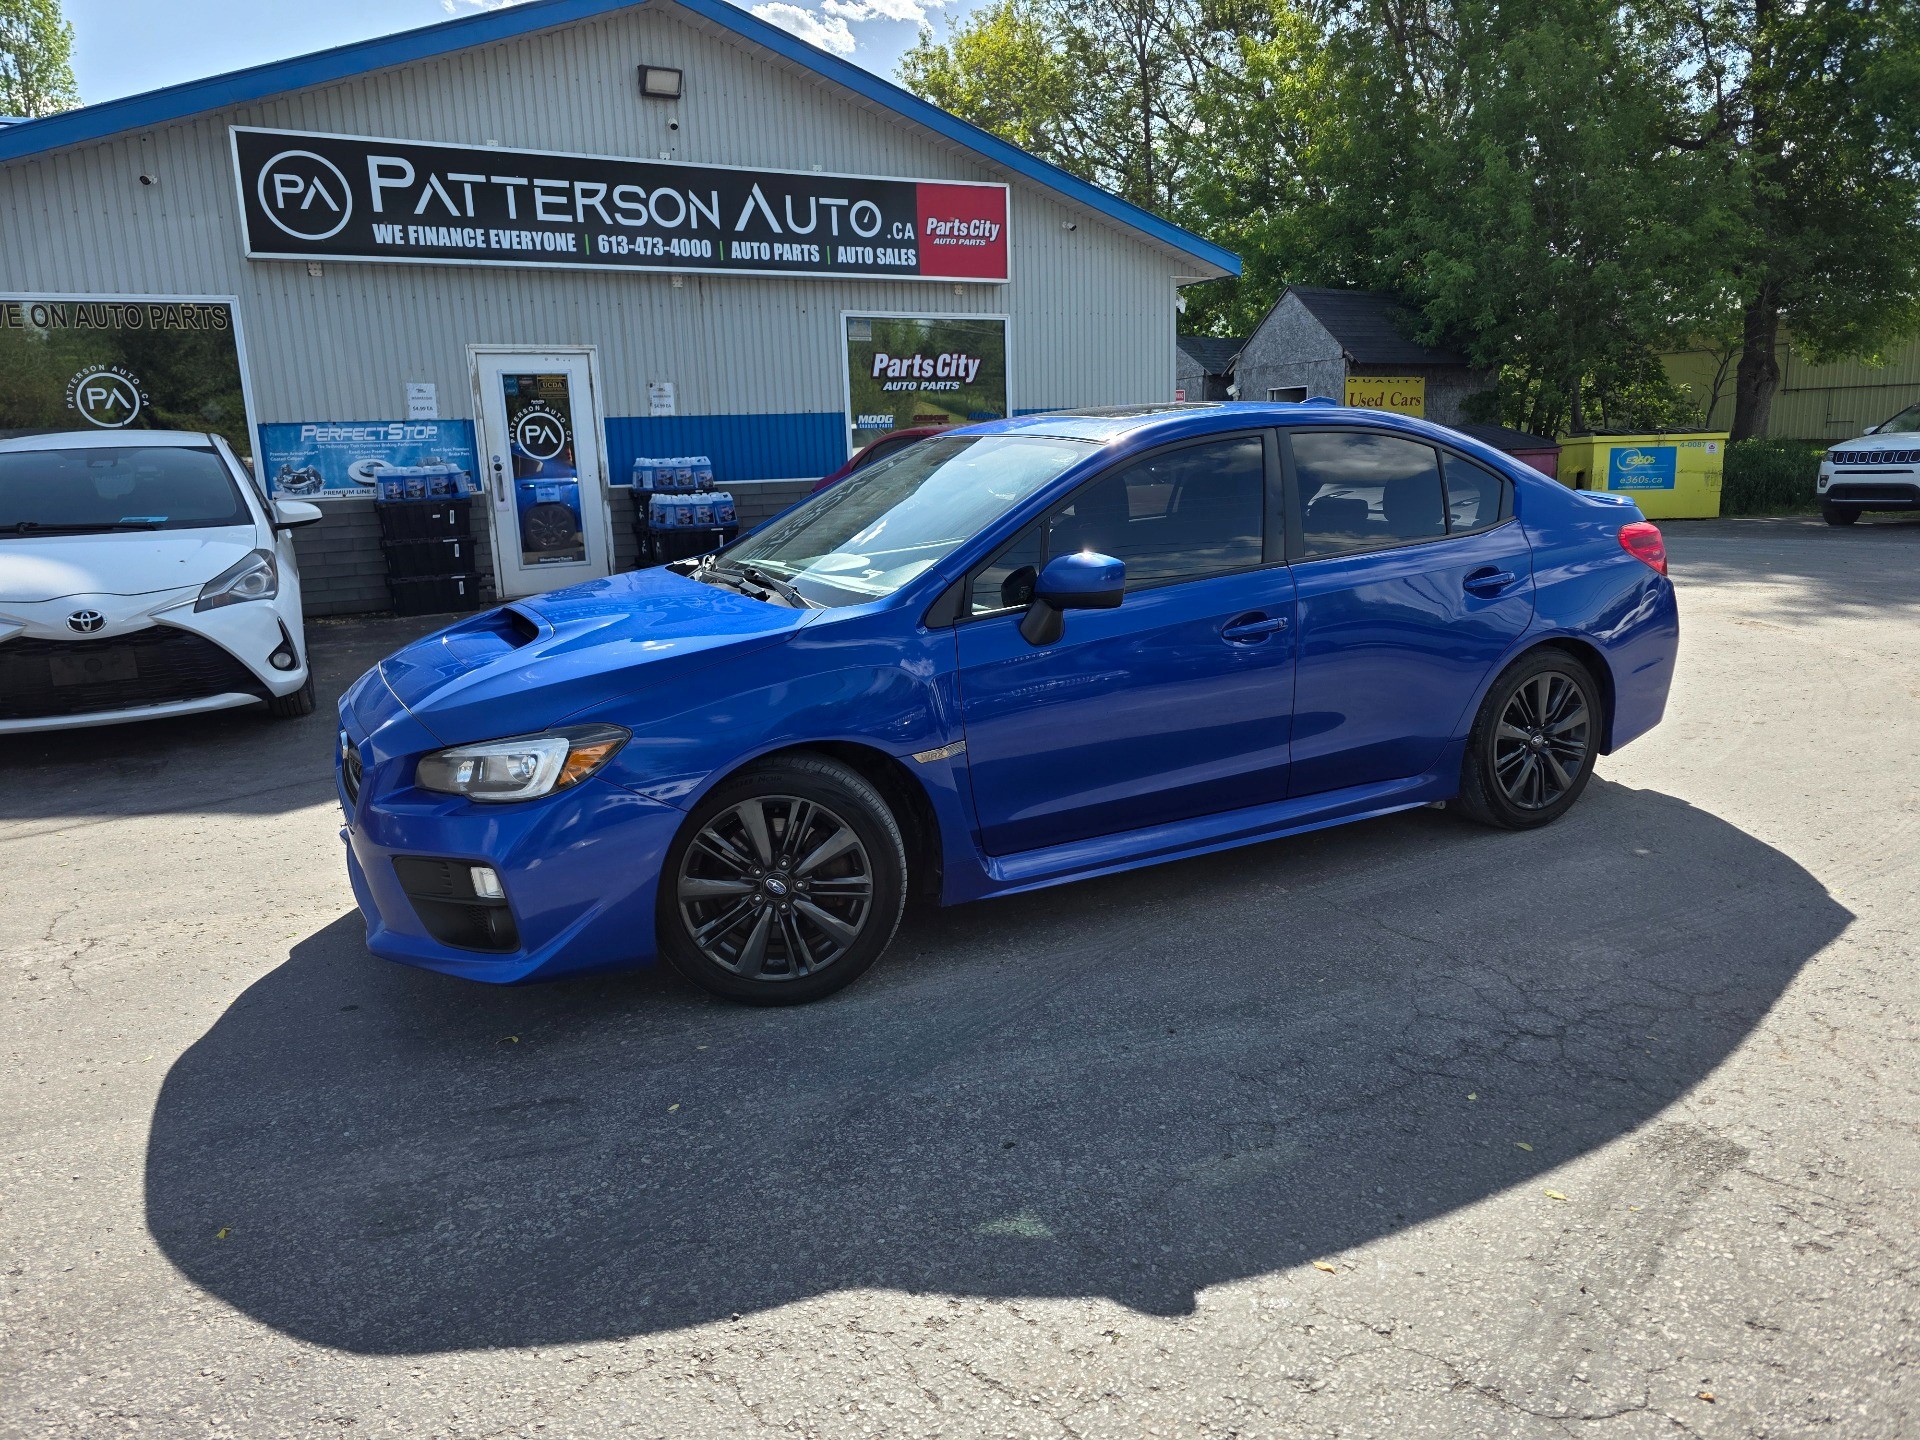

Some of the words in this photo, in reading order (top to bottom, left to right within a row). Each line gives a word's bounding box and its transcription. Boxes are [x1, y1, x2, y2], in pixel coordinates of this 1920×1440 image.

[273, 173, 340, 212] PA
[366, 154, 721, 231] PATTERSON
[372, 224, 403, 245] WE
[408, 226, 486, 249] FINANCE
[488, 229, 577, 253] EVERYONE
[597, 234, 712, 259] 613-473-4000
[731, 241, 771, 261] AUTO
[774, 244, 820, 263] PARTS
[837, 248, 874, 264] AUTO
[876, 249, 917, 267] SALES
[933, 238, 957, 246] AUTO
[958, 238, 987, 247] PARTS
[30, 303, 69, 329] ON
[74, 304, 144, 330] AUTO
[149, 304, 229, 330] PARTS
[67, 364, 105, 409] PATTERSON
[112, 365, 140, 386] AUTO
[882, 381, 918, 391] AUTO
[919, 381, 961, 391] PARTS
[86, 387, 132, 410] PA
[1349, 392, 1385, 408] Used
[1390, 391, 1421, 407] Cars
[510, 405, 541, 444] PATTERSON
[544, 406, 566, 424] AUTO
[857, 414, 894, 424] MOOG
[524, 425, 558, 445] PA
[1619, 475, 1663, 484] e360s.ca
[356, 488, 371, 496] LINE
[920, 750, 946, 761] WRX
